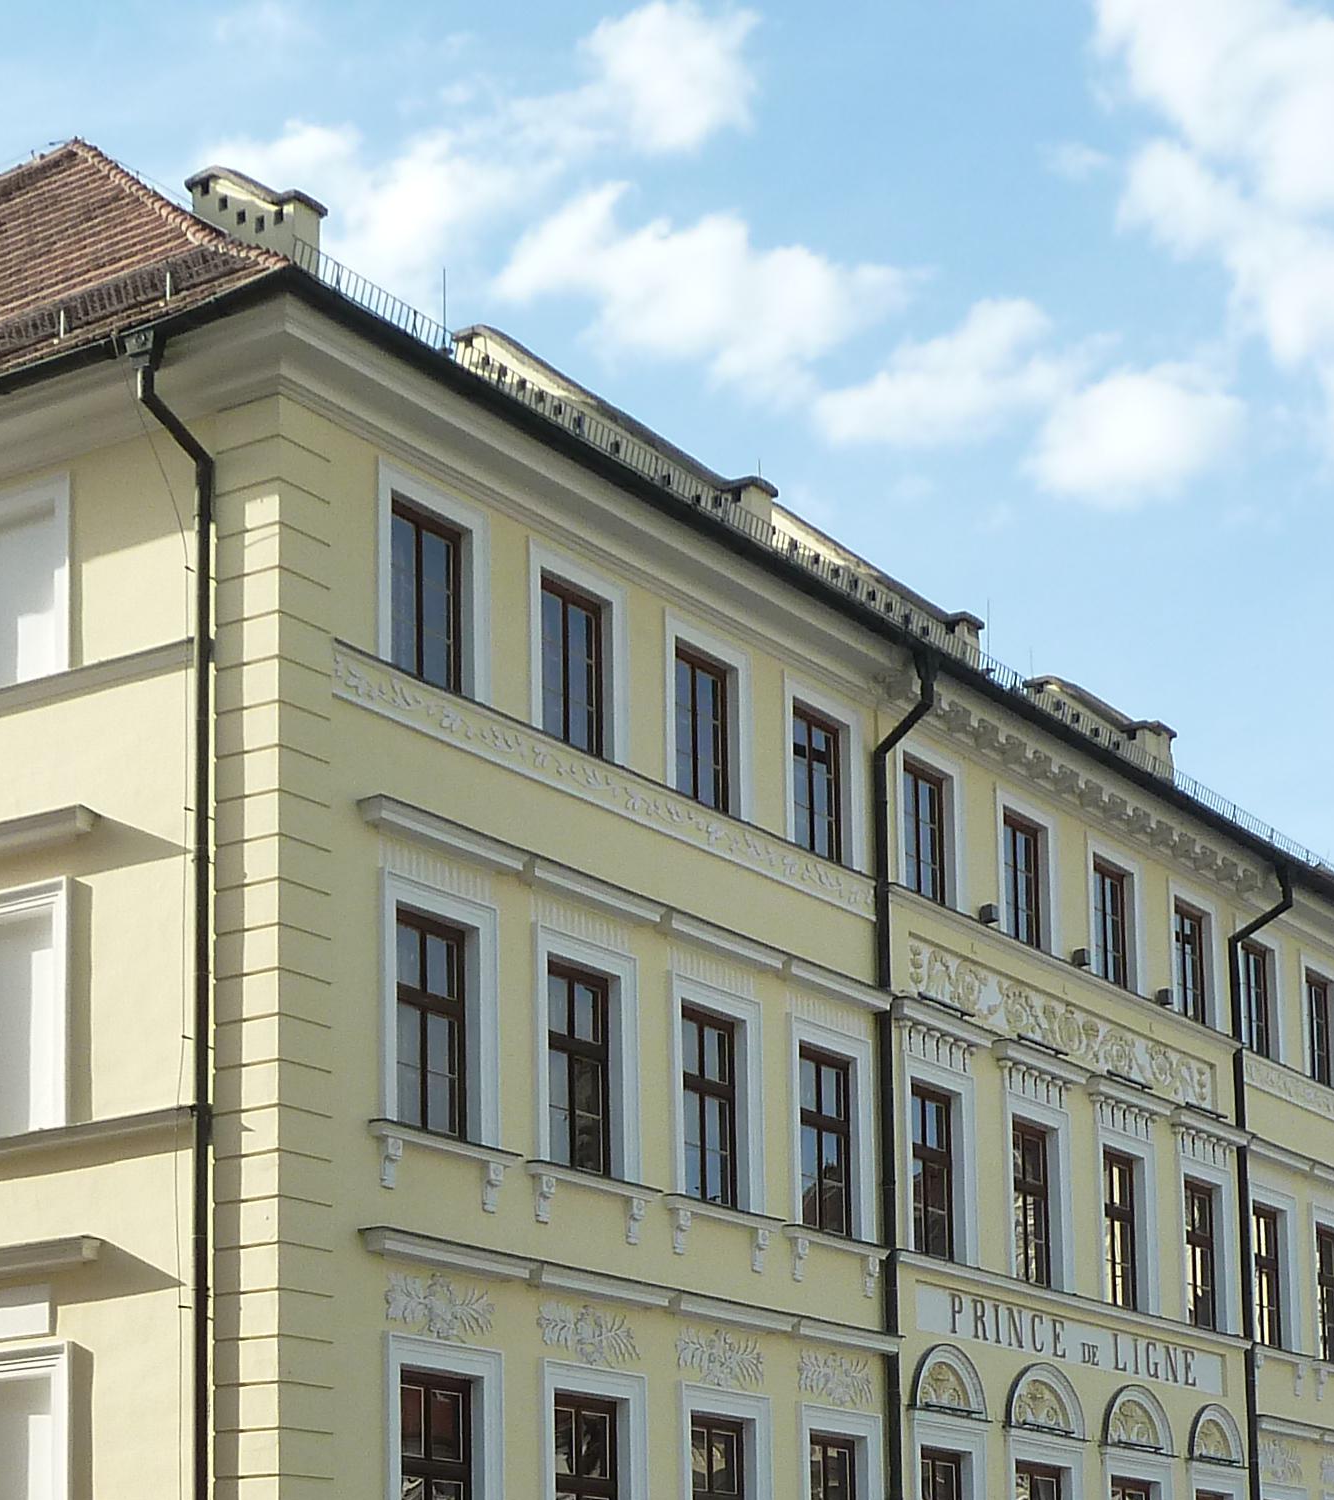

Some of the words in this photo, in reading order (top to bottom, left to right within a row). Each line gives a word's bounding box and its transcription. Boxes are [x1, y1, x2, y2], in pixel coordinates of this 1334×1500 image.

[949, 1293, 1066, 1358] PRINCE
[1081, 1342, 1099, 1366] DE
[1113, 1333, 1197, 1387] LIGNE
